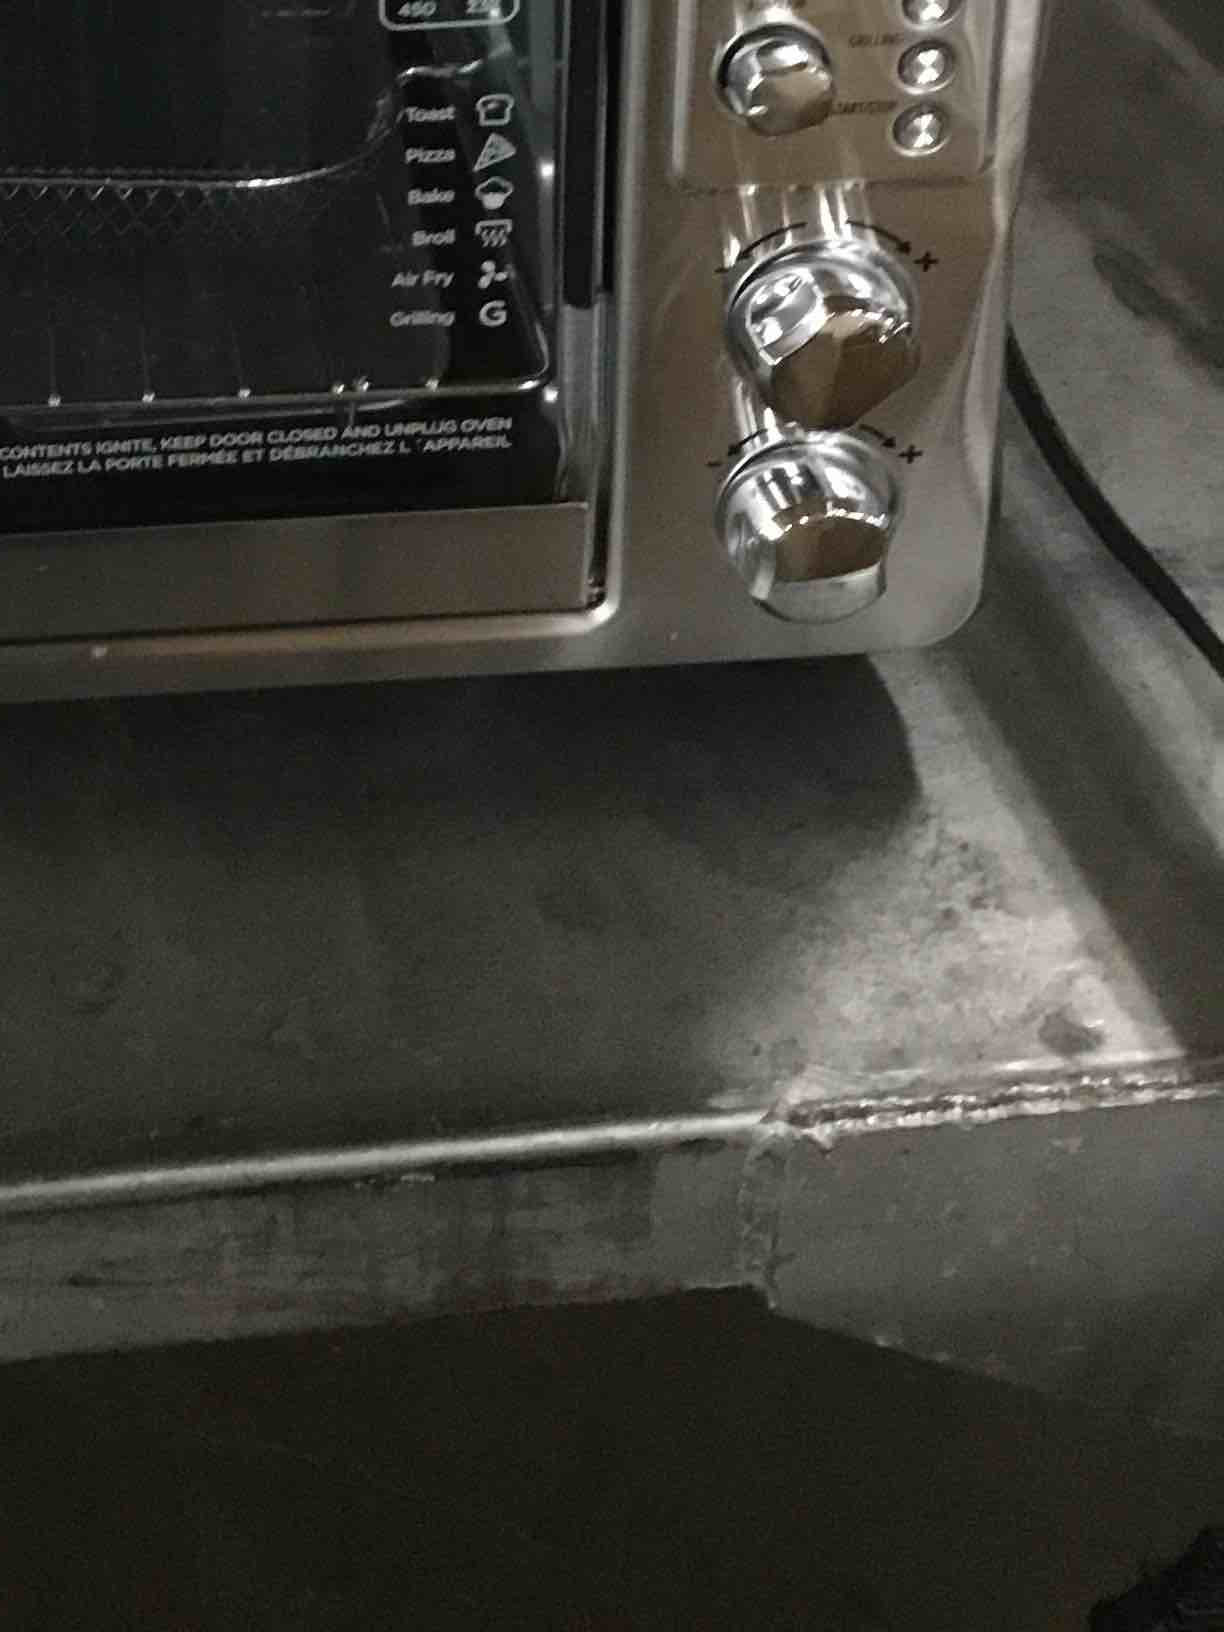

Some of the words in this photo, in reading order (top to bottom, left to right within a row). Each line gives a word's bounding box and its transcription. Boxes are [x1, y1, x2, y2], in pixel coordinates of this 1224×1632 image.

[396, 0, 438, 18] 450
[406, 105, 456, 123] Toast
[404, 148, 456, 164] Pizza
[407, 188, 456, 205] Bake
[411, 228, 456, 247] Broil
[390, 271, 418, 288] Air
[421, 269, 455, 288] Fry
[160, 435, 206, 451] KEEP
[209, 431, 263, 447] DOOR
[267, 426, 338, 445] CLOSED
[341, 424, 381, 440] AND
[384, 419, 457, 437] UNPLUG
[459, 416, 513, 433] OVEN
[2, 460, 74, 479] LAISSEZ
[77, 459, 102, 474] LA
[105, 454, 163, 472] PORTE
[242, 448, 266, 463] ET
